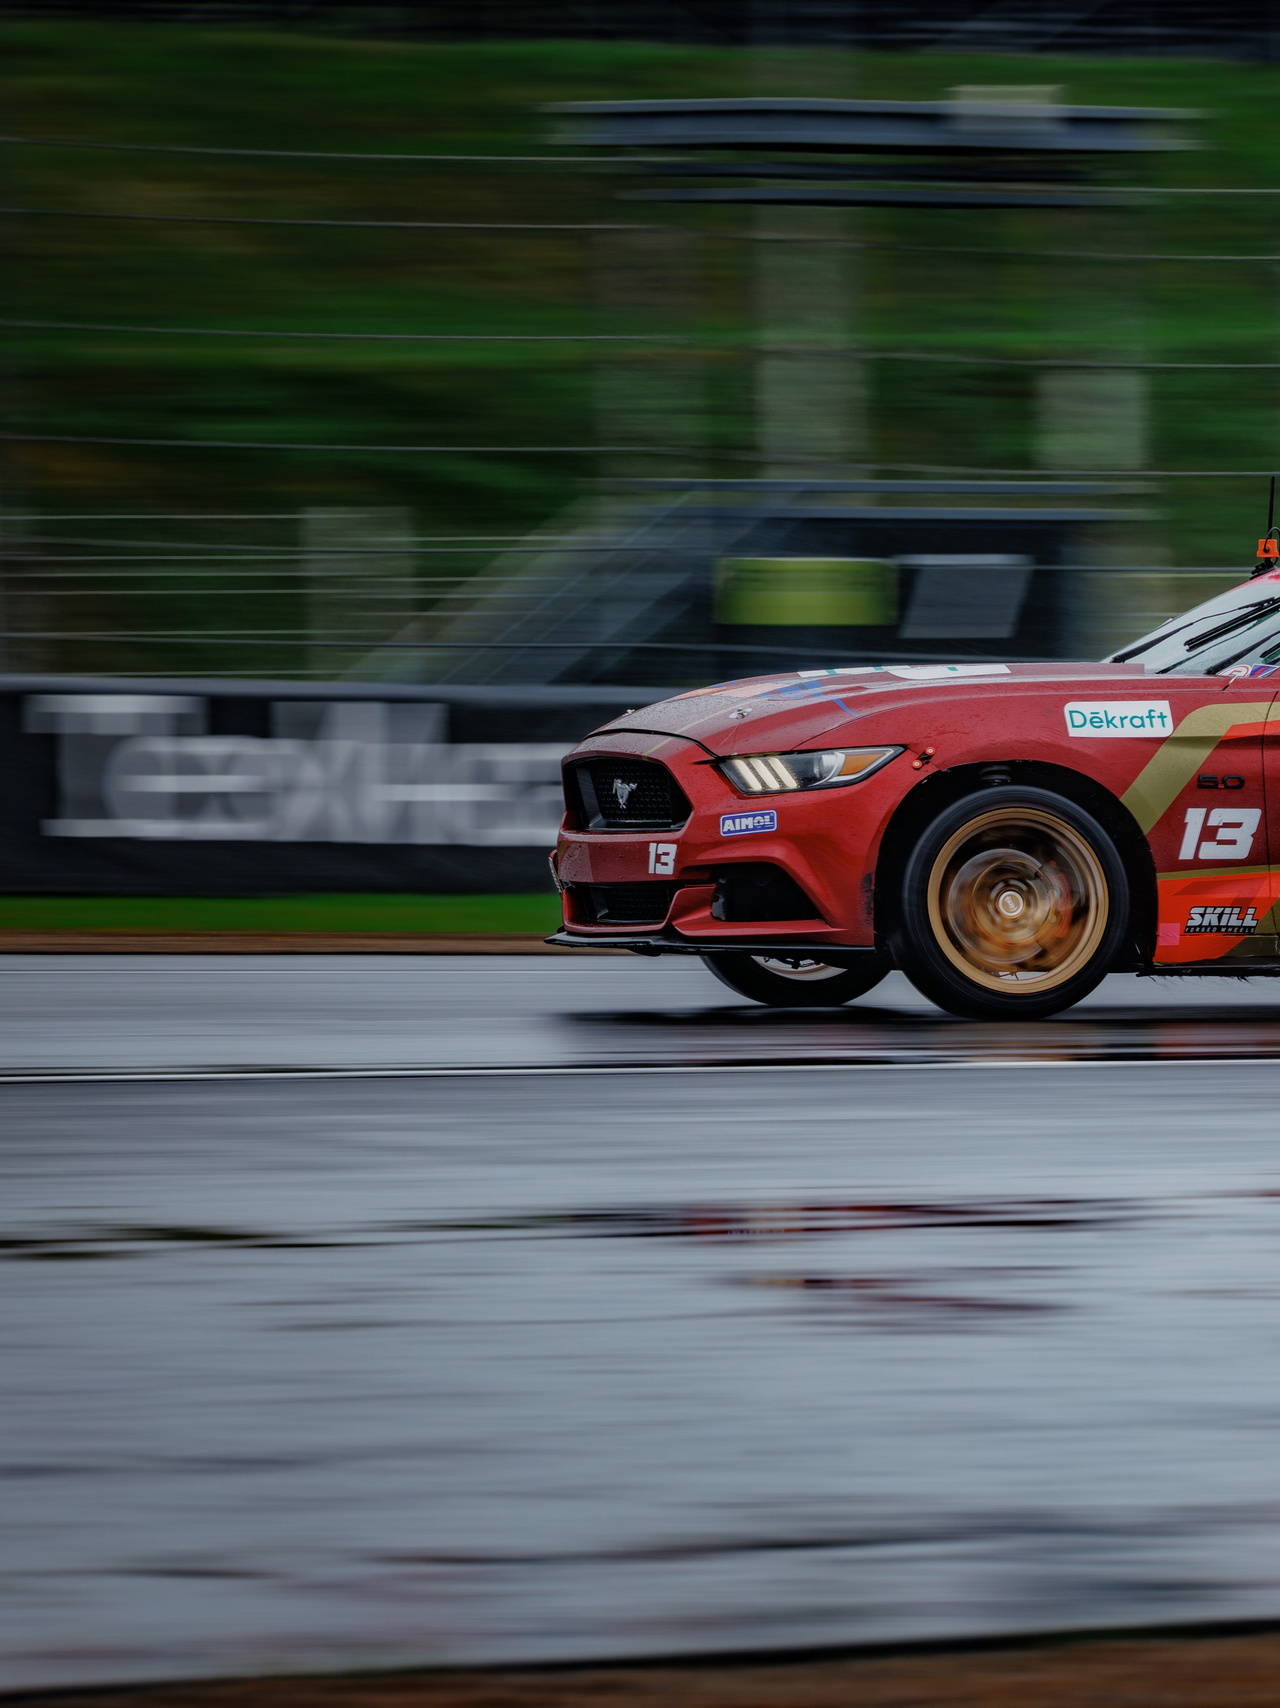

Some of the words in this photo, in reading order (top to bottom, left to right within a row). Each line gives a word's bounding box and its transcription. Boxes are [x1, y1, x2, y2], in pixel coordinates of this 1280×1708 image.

[1068, 709, 1168, 729] Dēkraft
[722, 815, 774, 832] AIMOL
[1178, 807, 1262, 860] 13
[648, 842, 678, 875] 13
[1186, 906, 1258, 927] SKILL
